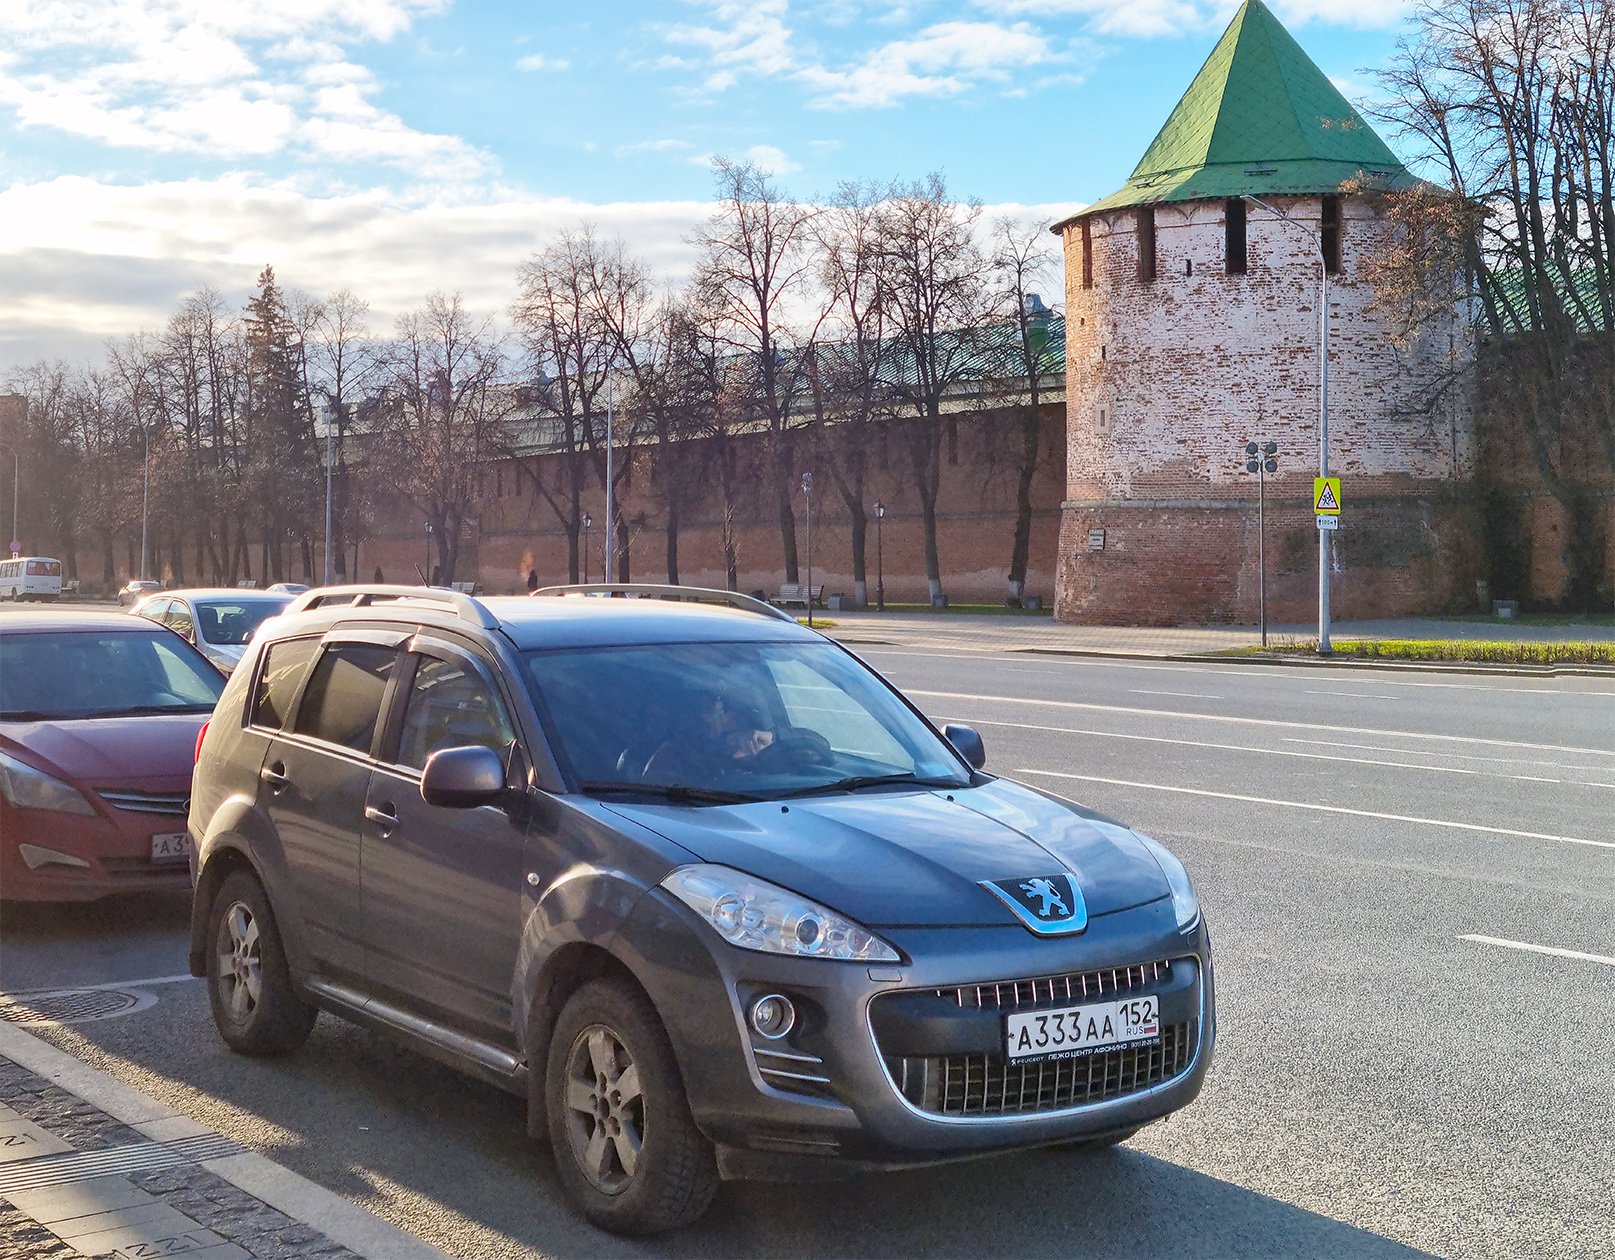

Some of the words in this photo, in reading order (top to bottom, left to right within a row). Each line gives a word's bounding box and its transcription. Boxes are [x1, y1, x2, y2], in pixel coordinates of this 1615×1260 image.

[1119, 1000, 1152, 1026] 152
[1126, 1025, 1144, 1036] RUS
[1048, 1052, 1070, 1060] ПЕЖО
[1071, 1048, 1092, 1058] ЦЕНТР
[1093, 1043, 1127, 1054] АФОНИНО
